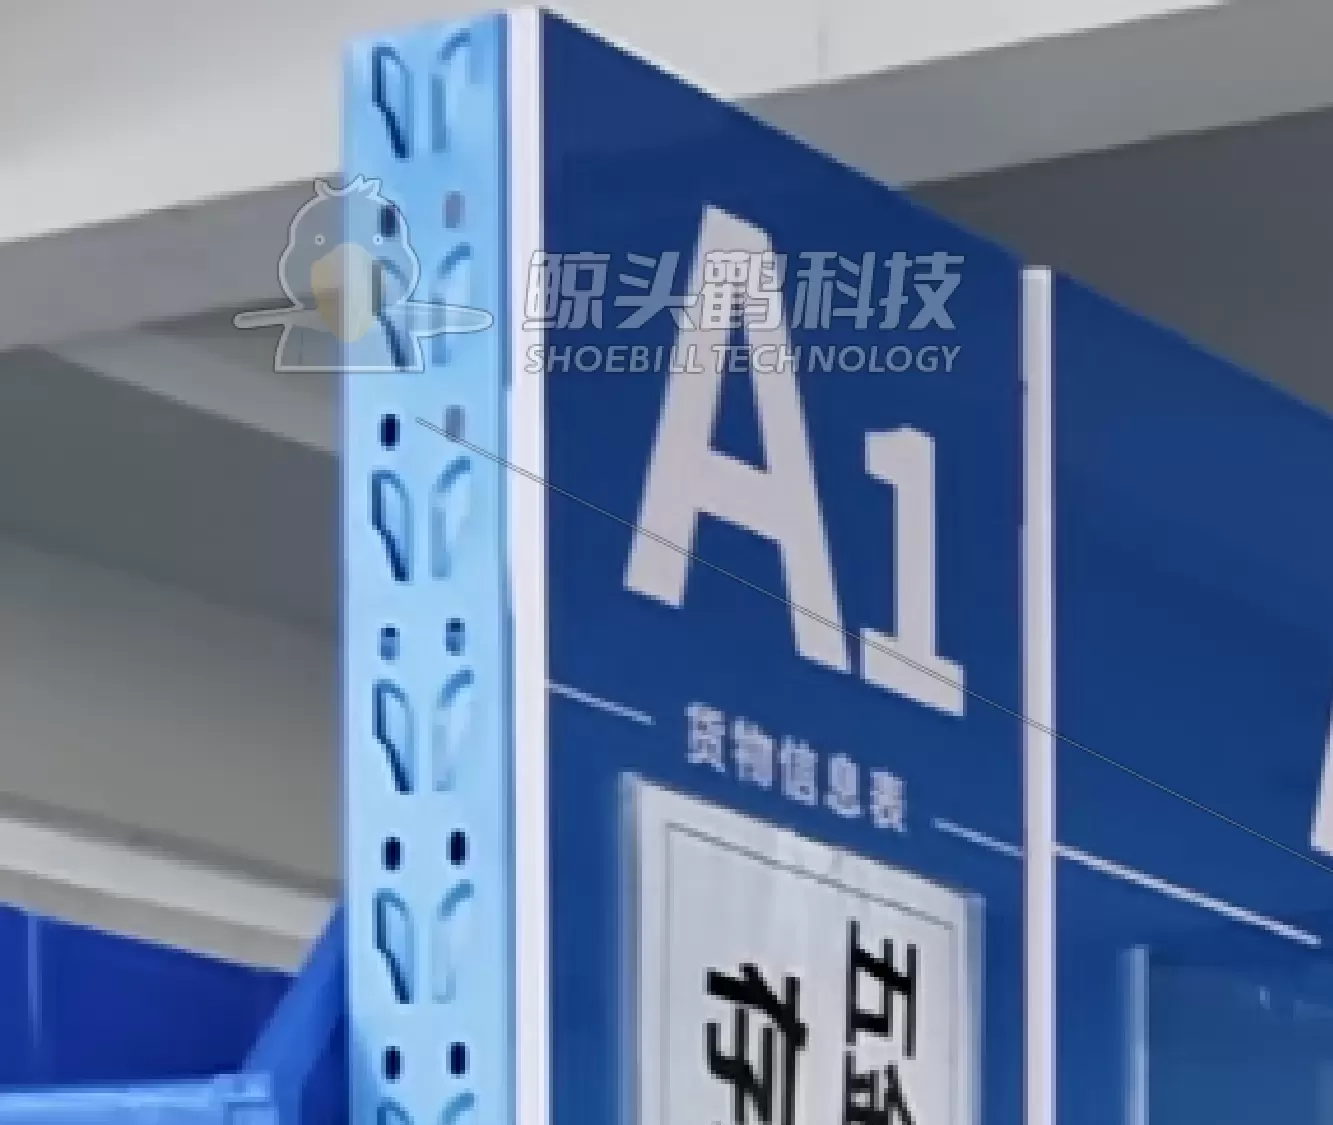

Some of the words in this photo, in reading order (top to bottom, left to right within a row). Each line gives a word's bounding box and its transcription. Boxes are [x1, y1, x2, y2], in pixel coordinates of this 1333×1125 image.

[622, 204, 964, 717] A1
[684, 701, 909, 834] 货物信息表
